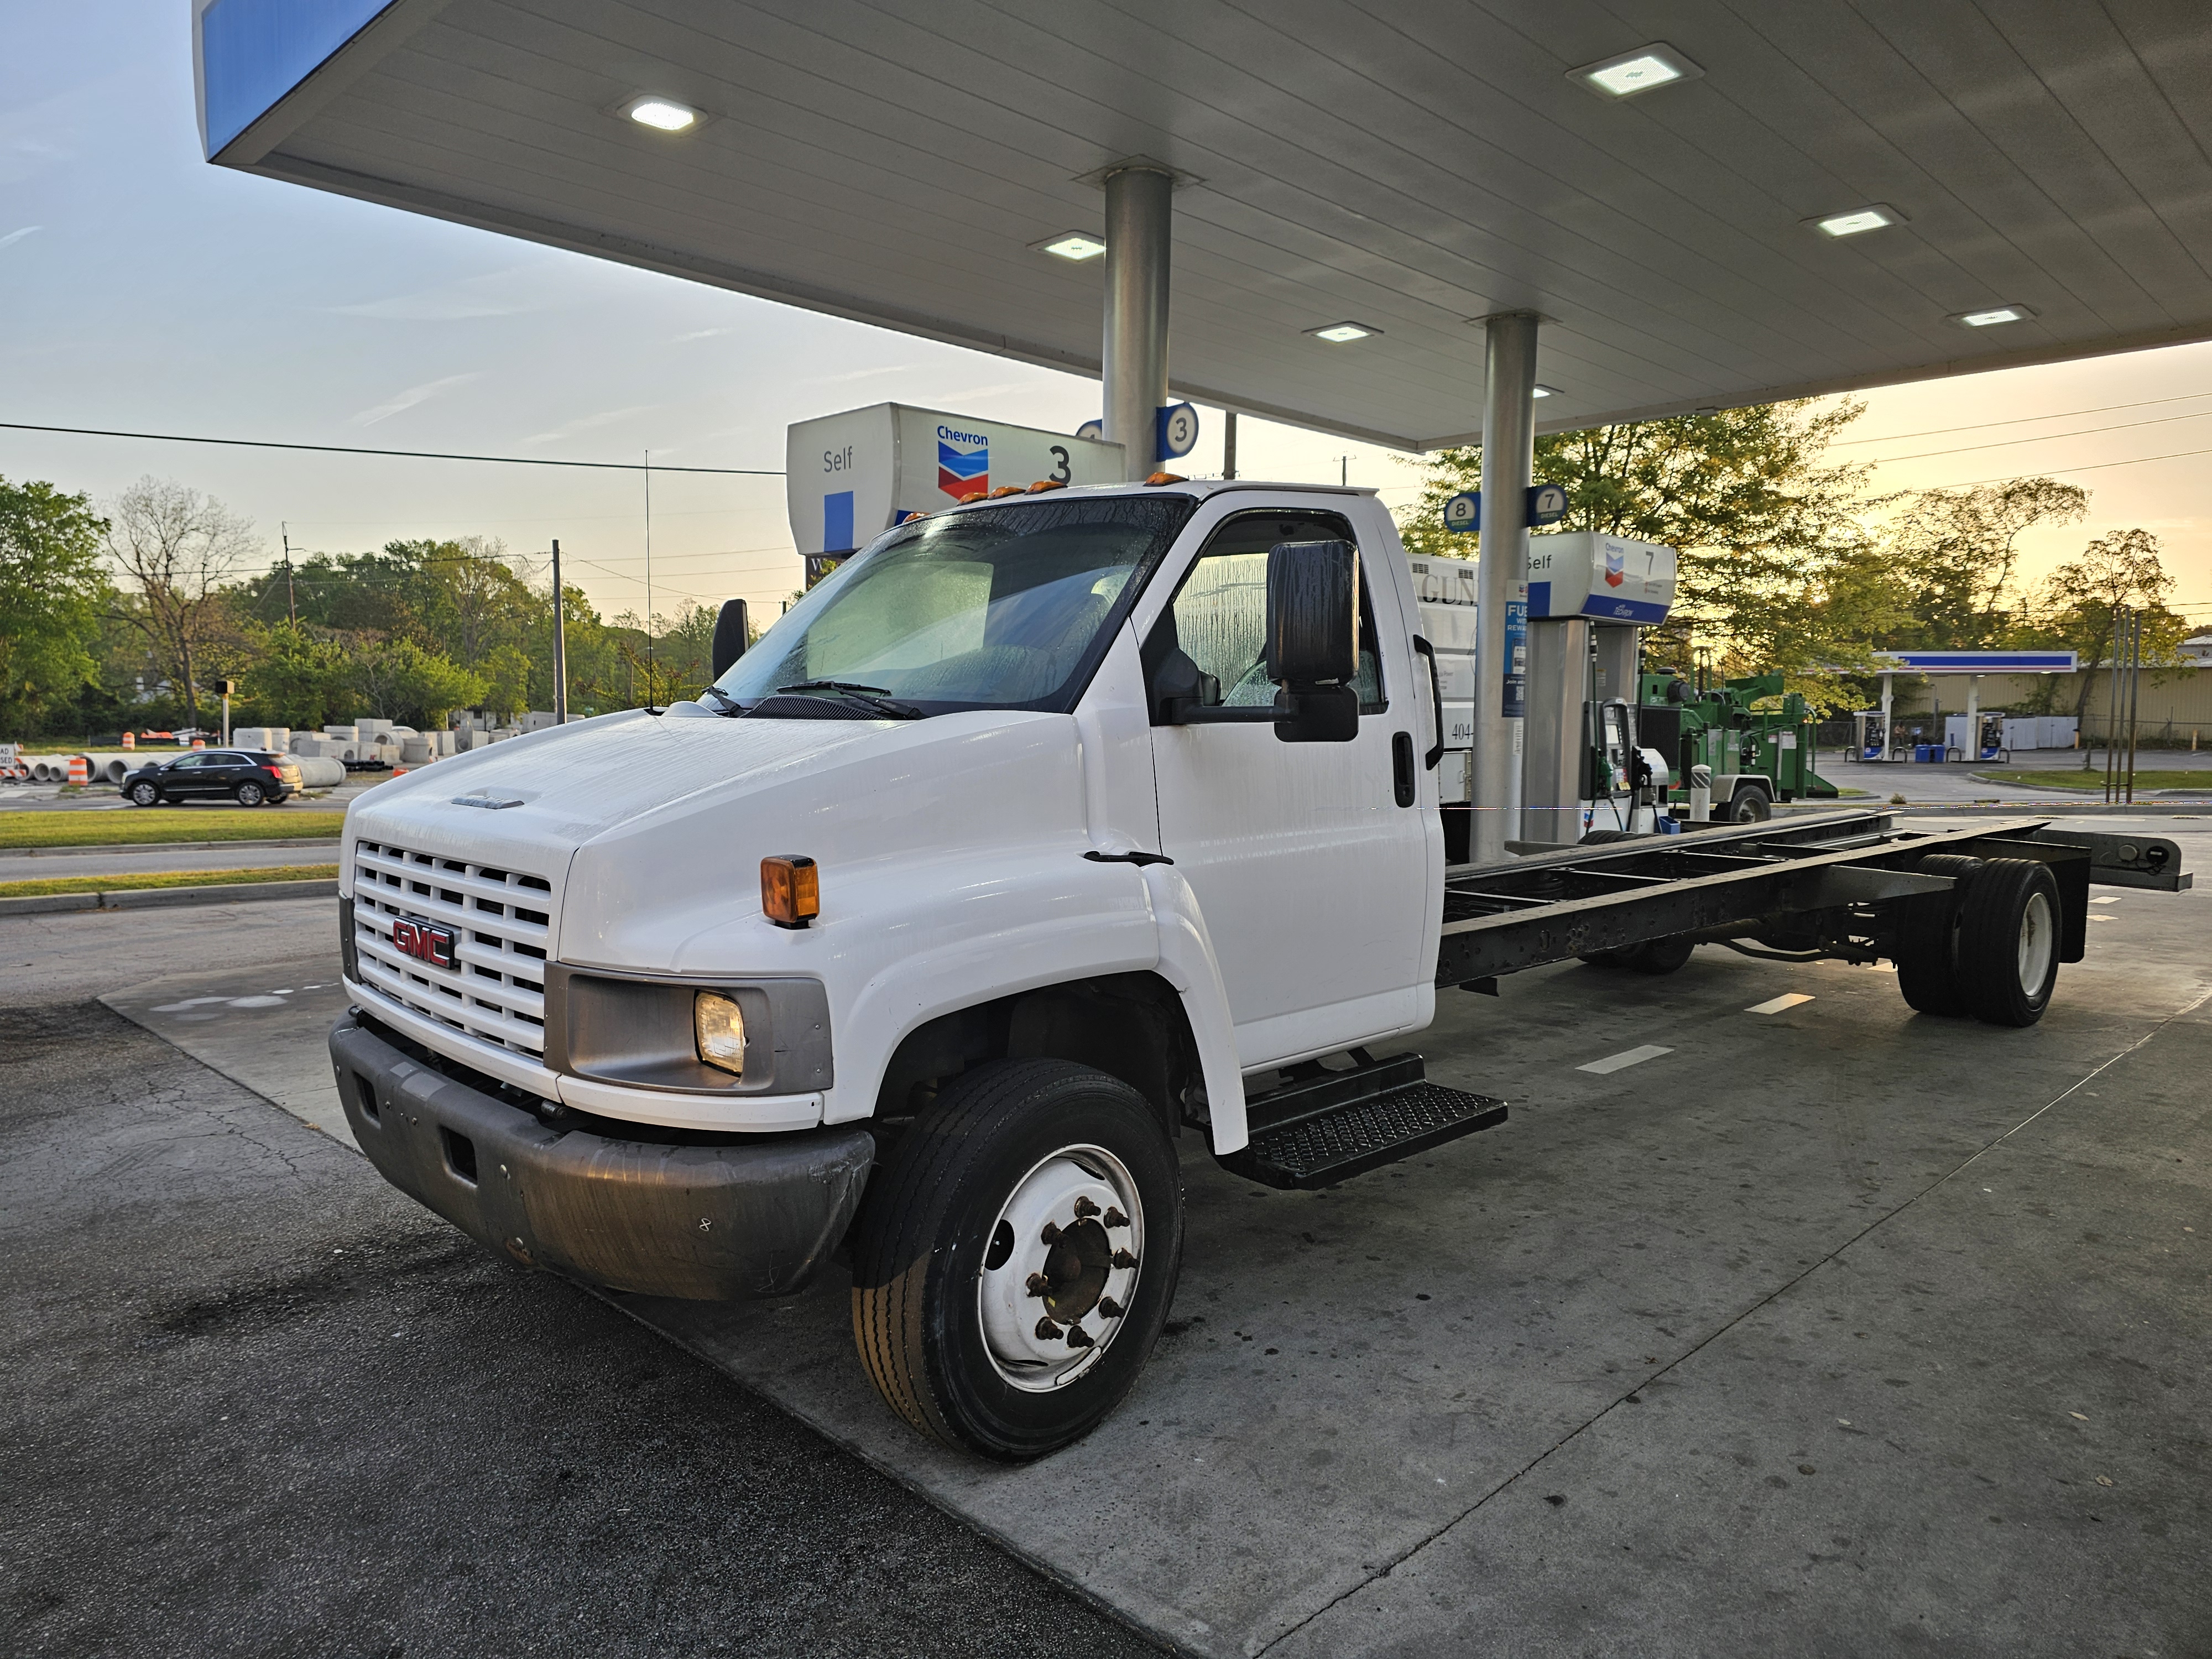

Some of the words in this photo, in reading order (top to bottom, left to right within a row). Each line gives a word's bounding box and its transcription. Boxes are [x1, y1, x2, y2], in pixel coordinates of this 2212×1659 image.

[937, 425, 988, 446] Chevron
[1175, 418, 1187, 442] 3
[823, 445, 852, 473] Self
[1048, 445, 1072, 485] 3
[1455, 503, 1466, 517] 8
[1545, 493, 1555, 509] 7
[1605, 542, 1624, 554] Chevron
[1645, 551, 1654, 576] 7
[1421, 574, 1478, 607] GUN
[393, 918, 450, 967] GMC
